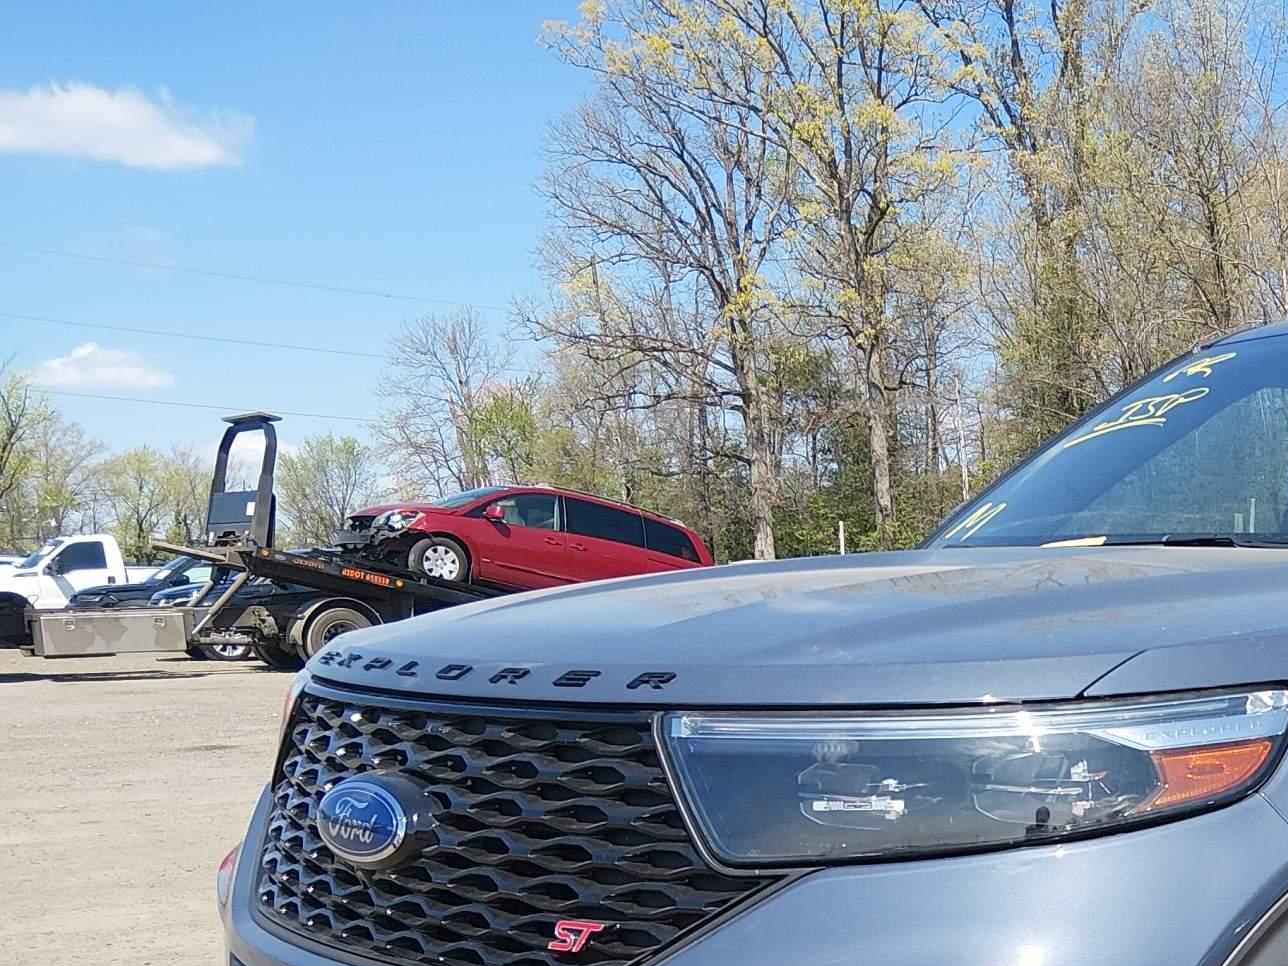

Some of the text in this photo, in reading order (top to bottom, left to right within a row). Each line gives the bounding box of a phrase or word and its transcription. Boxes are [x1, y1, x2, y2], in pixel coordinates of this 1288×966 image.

[318, 650, 679, 690] EXPLORER
[328, 796, 379, 844] Ford
[547, 920, 606, 953] ST
